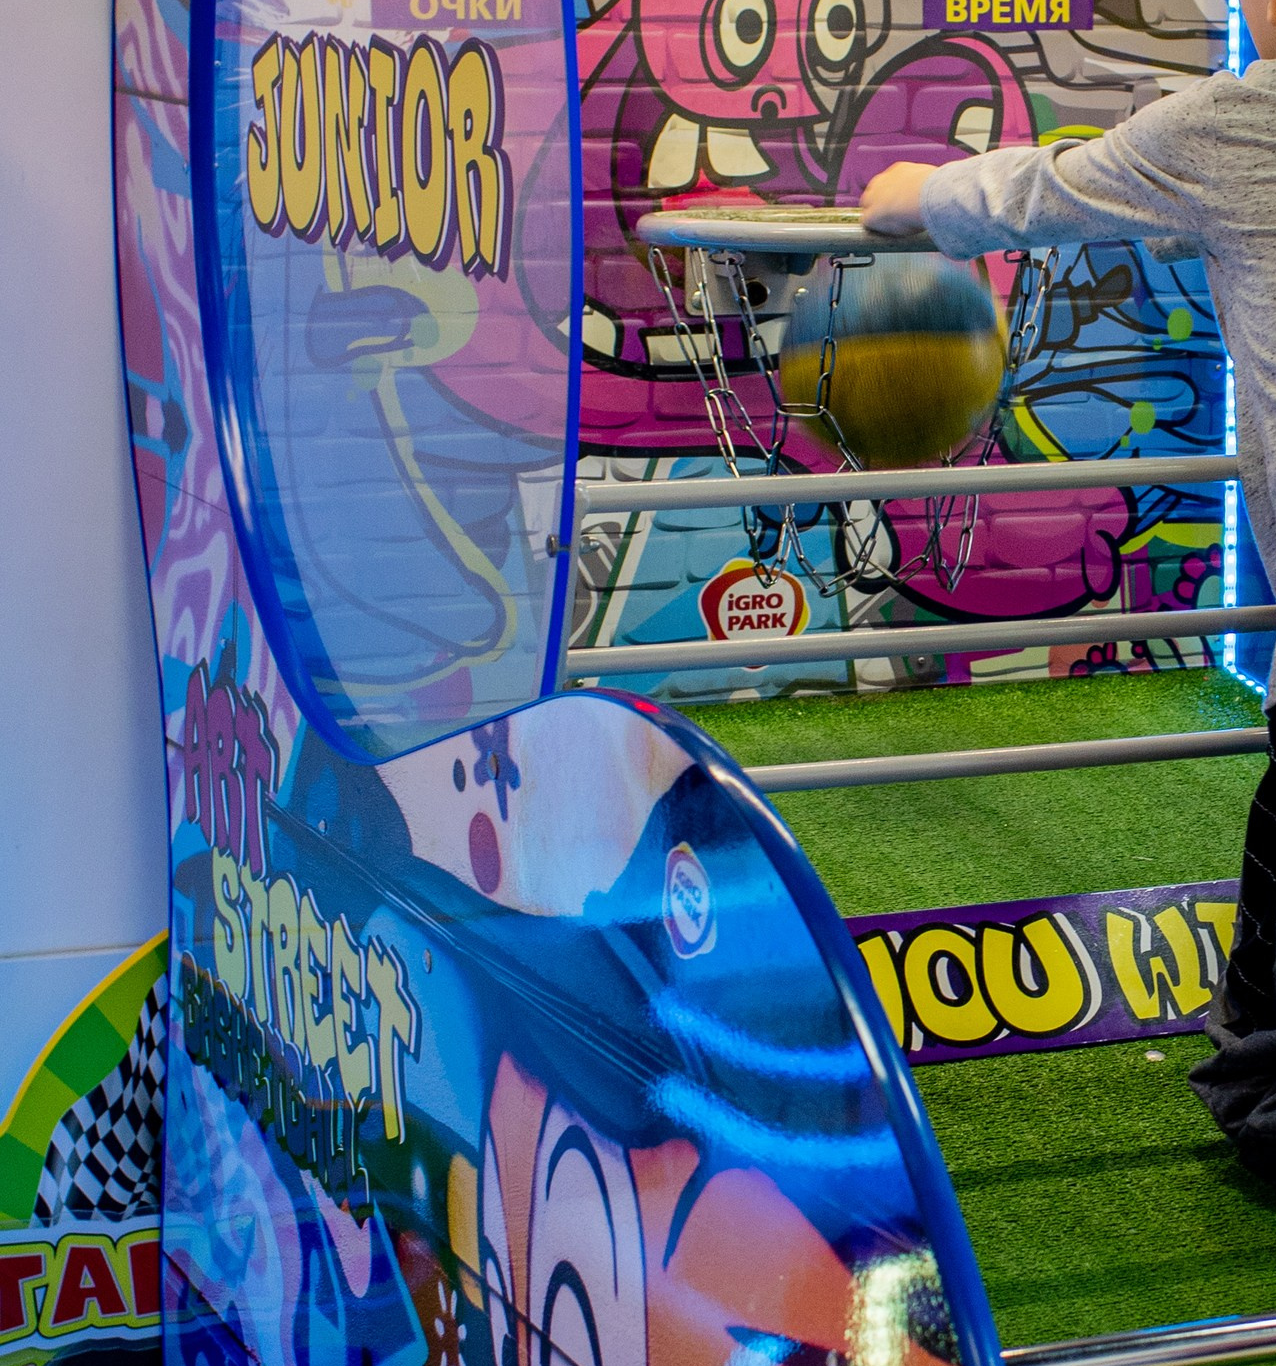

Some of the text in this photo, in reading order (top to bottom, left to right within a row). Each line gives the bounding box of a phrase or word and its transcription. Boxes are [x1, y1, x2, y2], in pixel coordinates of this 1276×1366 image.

[247, 30, 514, 282] JUNIOR
[727, 592, 784, 612] iGRO
[727, 611, 788, 632] PARK
[183, 657, 280, 878] ART
[211, 848, 422, 1146] STREET
